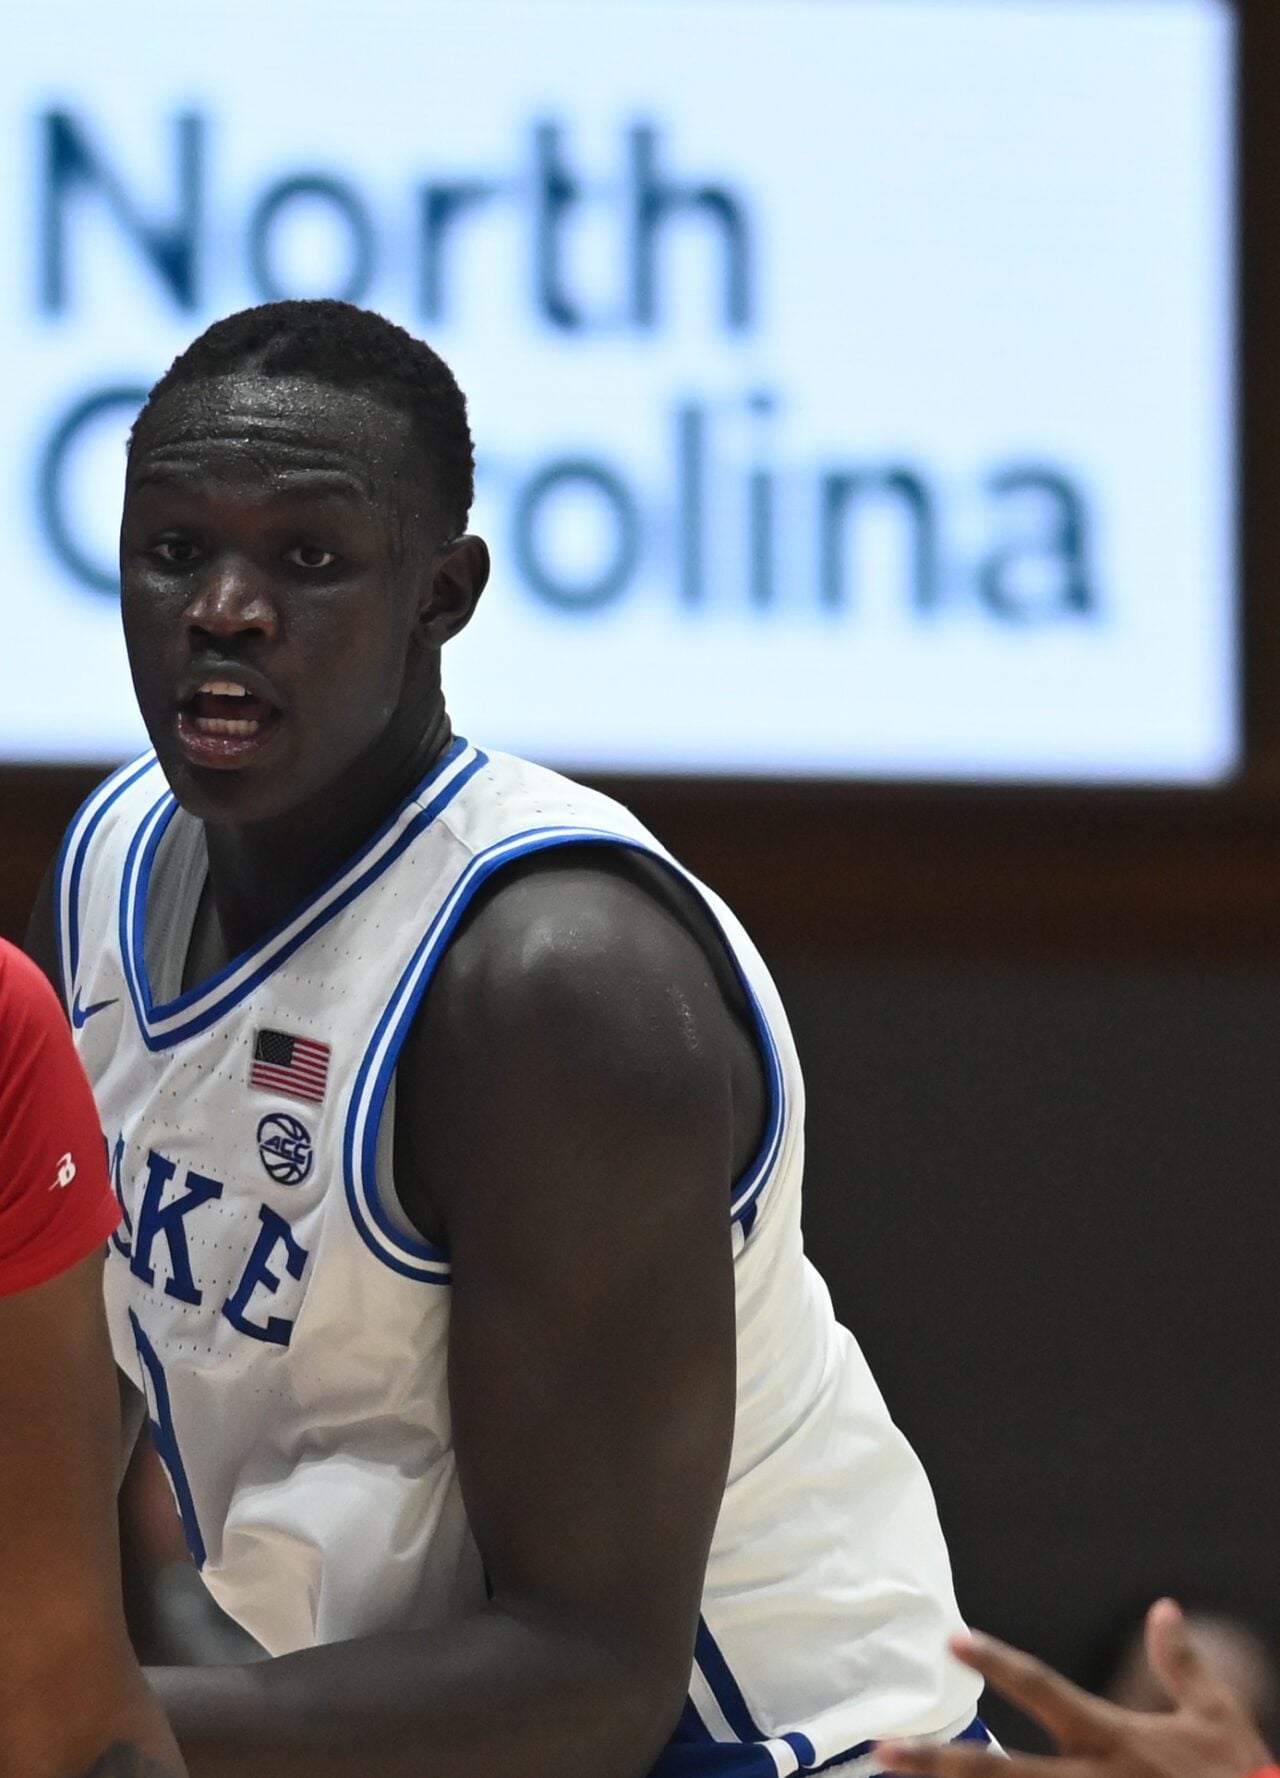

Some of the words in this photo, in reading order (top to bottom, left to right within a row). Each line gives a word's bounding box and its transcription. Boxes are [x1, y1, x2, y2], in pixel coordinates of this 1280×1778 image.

[38, 104, 756, 334] North
[38, 384, 1104, 626] Colina
[263, 1134, 311, 1165] ACC
